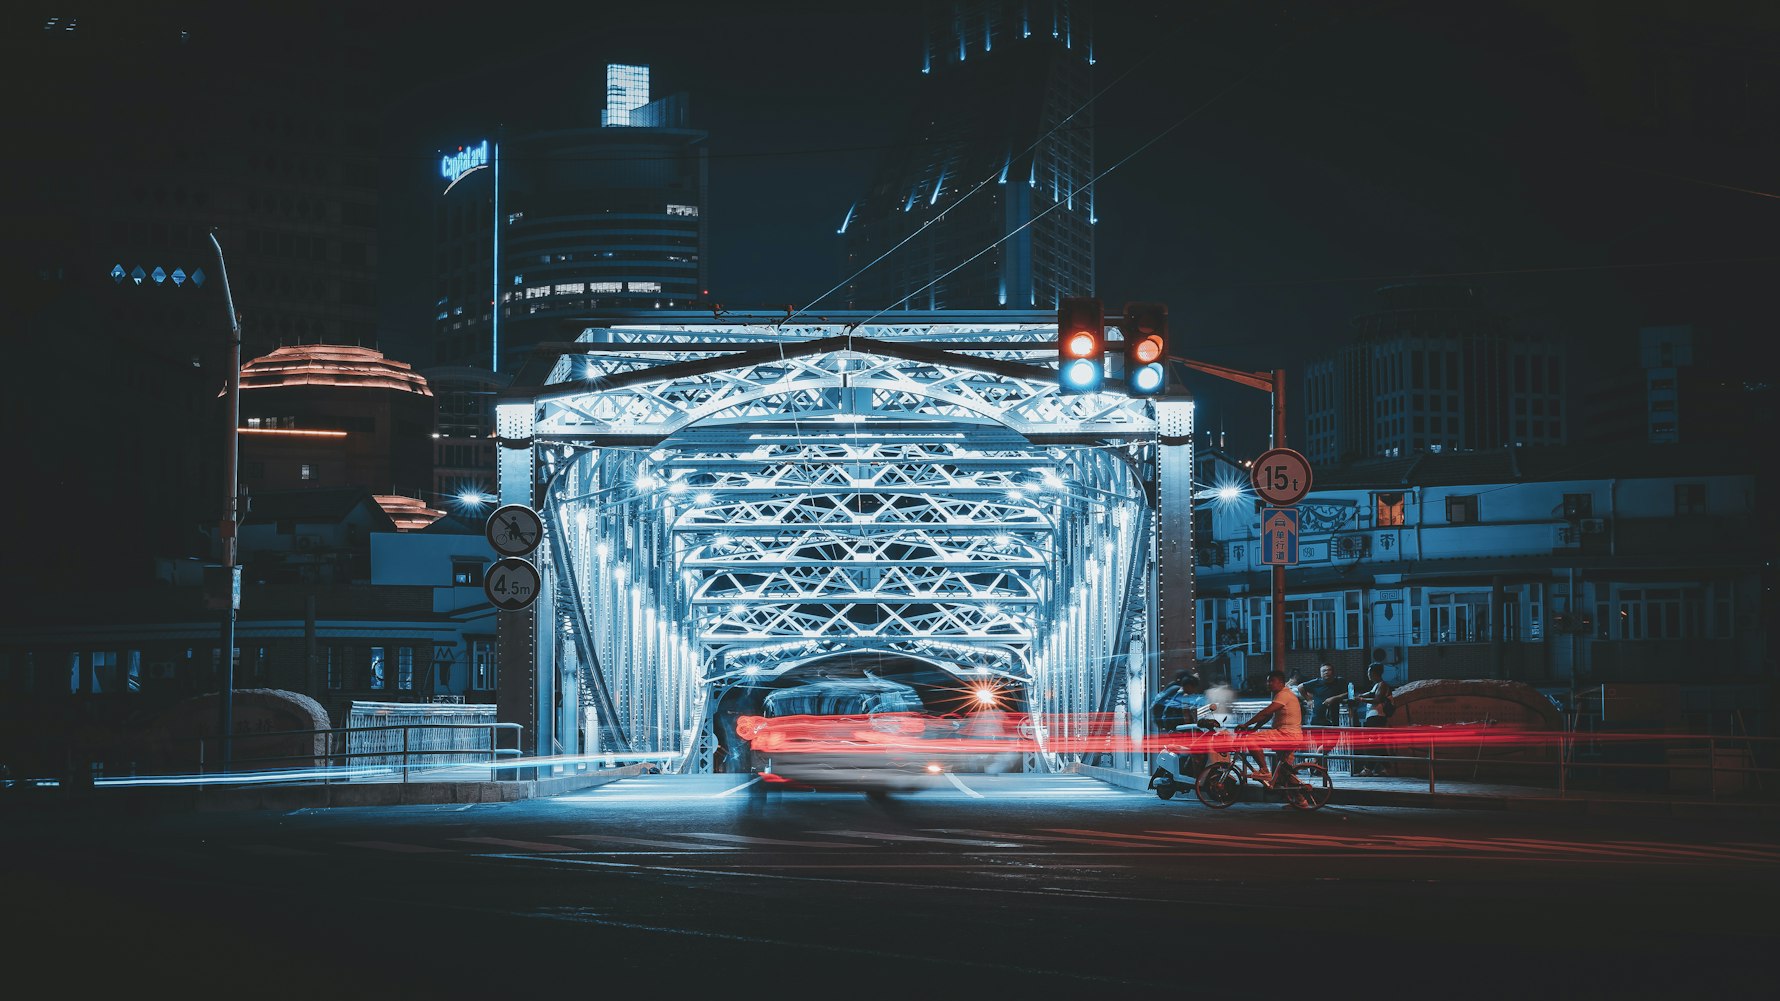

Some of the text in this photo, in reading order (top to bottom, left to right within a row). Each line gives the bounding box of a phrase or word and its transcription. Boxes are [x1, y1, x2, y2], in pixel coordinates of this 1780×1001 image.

[1275, 530, 1285, 560] 单行道
[493, 574, 531, 595] 4.5m
